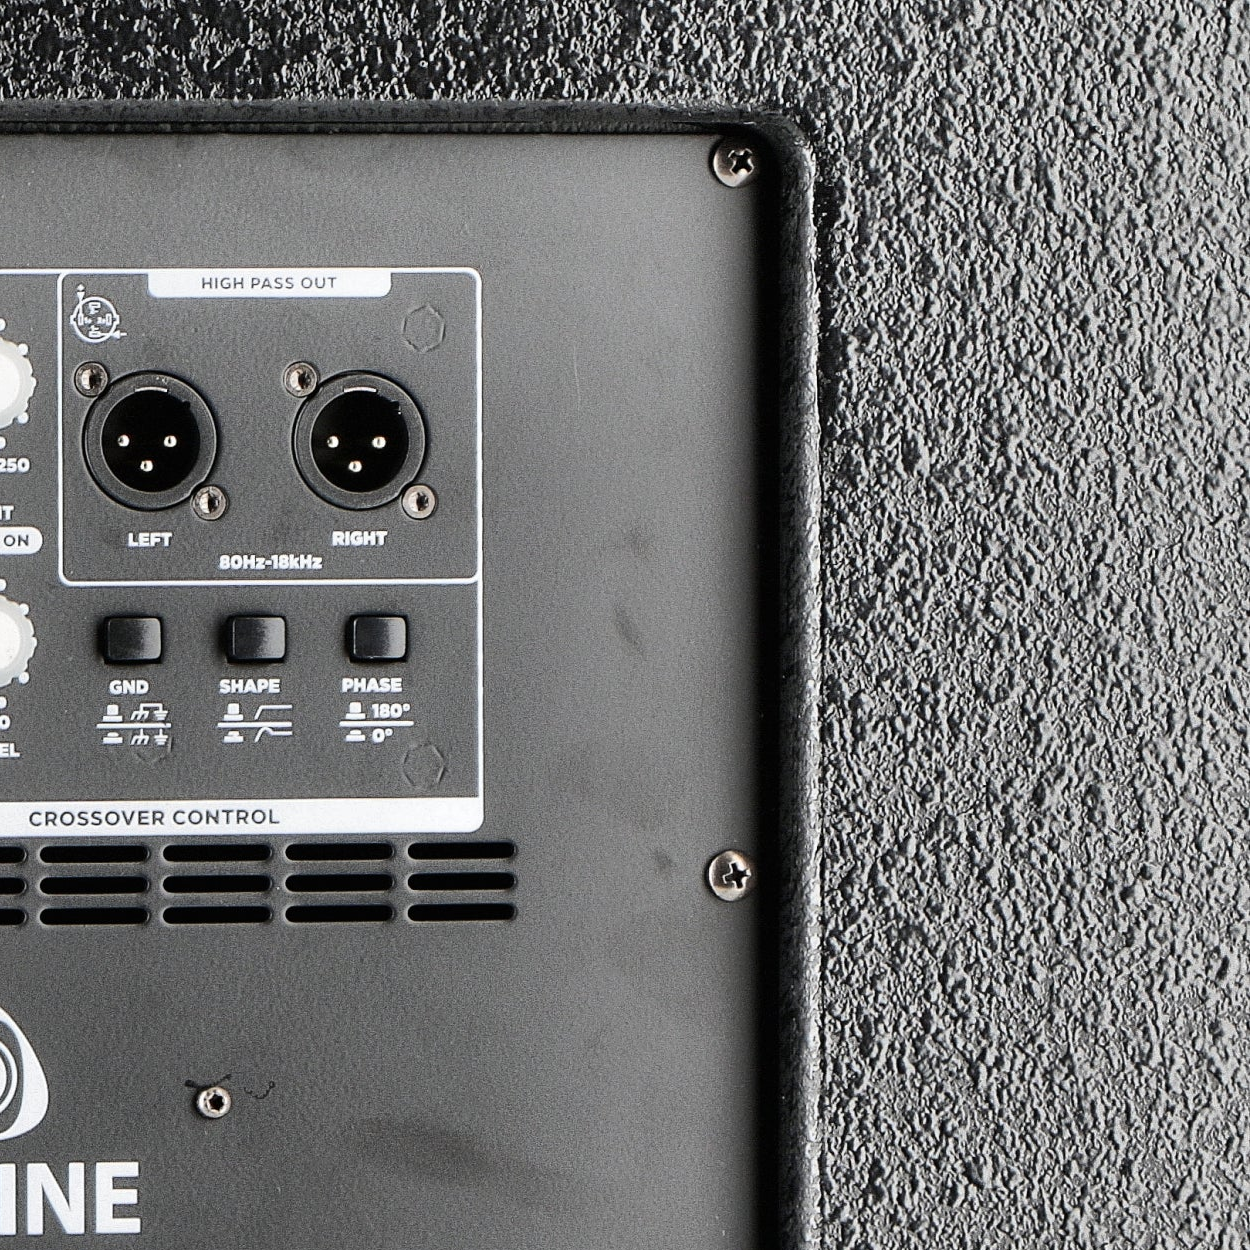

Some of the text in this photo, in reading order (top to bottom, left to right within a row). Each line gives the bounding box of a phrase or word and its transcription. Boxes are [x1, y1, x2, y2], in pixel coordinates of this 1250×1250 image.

[202, 277, 336, 289] HIGH PASS OUT
[4, 535, 28, 546] ON
[128, 532, 172, 547] LEFT
[332, 531, 387, 546] RIGHT
[218, 554, 322, 569] 80Hz-18kHz
[109, 680, 148, 694] GND
[220, 679, 280, 694] SHAPE
[342, 678, 402, 692] PHASE
[372, 703, 410, 718] 180°
[372, 729, 393, 743] 0°
[29, 809, 279, 826] CROSSOVER CONTROL
